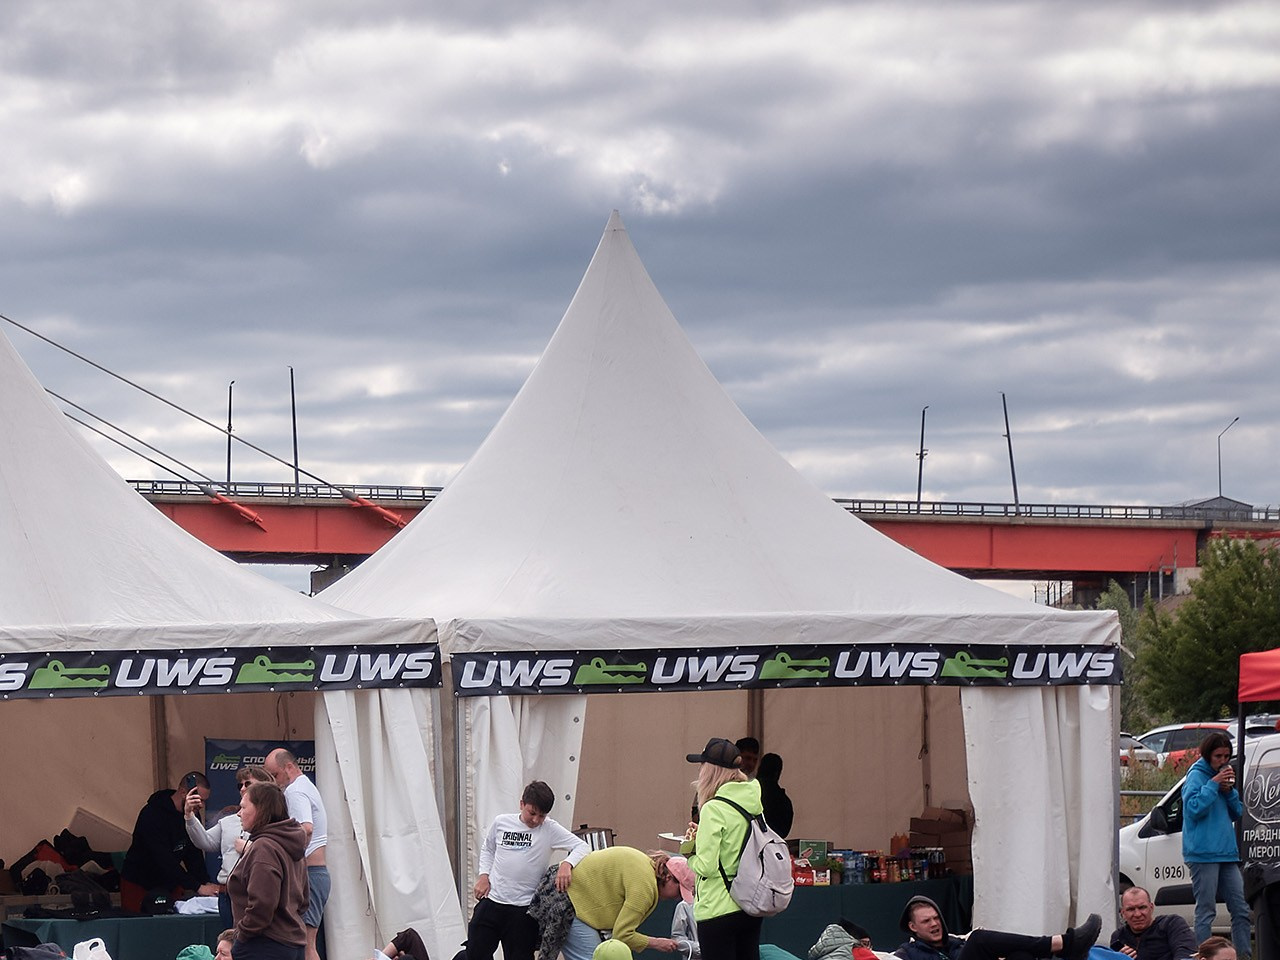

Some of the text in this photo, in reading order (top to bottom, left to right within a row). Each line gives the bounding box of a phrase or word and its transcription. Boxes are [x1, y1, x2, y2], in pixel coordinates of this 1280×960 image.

[114, 656, 237, 688] UWS
[319, 651, 436, 682] UWS
[460, 658, 574, 689] UWS
[650, 654, 760, 684] UWS
[834, 651, 942, 678] UWS
[1011, 652, 1115, 679] UWS
[210, 762, 239, 770] UWS
[242, 755, 316, 766] СПОНЫЙ
[502, 831, 533, 842] ORIGINAL
[1154, 865, 1185, 881] 8 (926)
